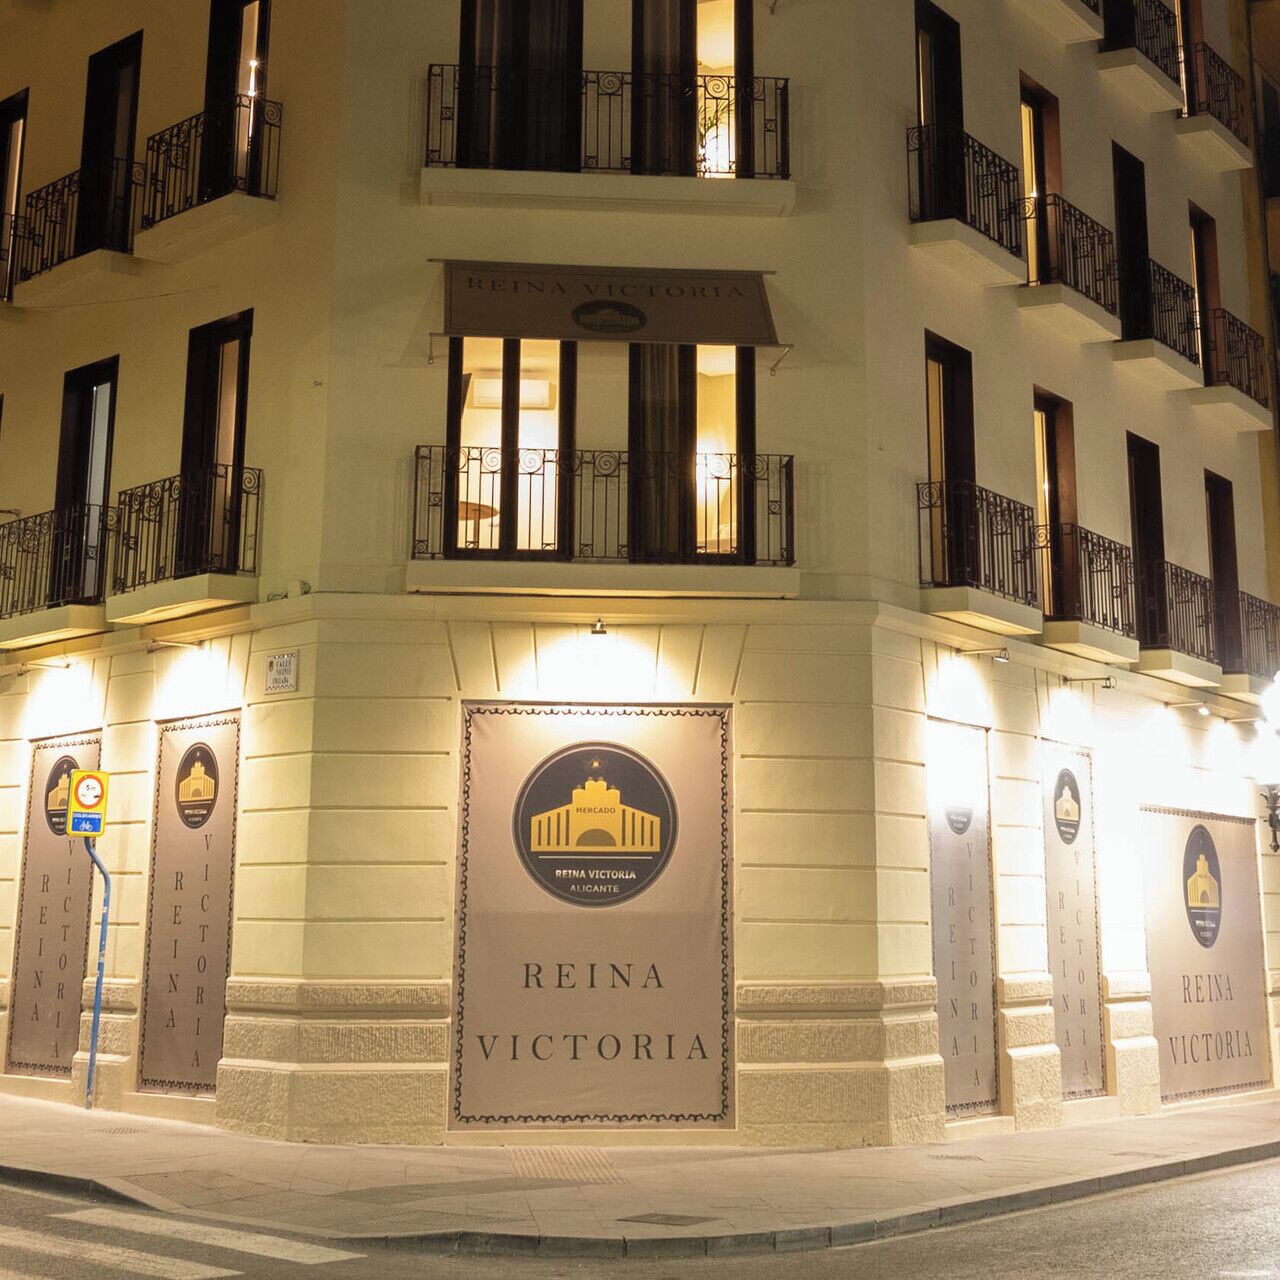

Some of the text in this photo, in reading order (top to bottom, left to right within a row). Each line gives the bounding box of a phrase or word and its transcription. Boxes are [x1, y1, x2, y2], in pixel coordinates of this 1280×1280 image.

[466, 276, 746, 300] REINA VICTORIA
[575, 806, 617, 815] MERCADO
[555, 869, 637, 880] REINA VICTORIA
[569, 884, 620, 894] ALICANTE
[30, 873, 50, 1023] REINA
[50, 838, 77, 1058] VICTORIA
[165, 870, 184, 1029] REINA
[190, 833, 214, 1069] VICTORIA
[522, 962, 666, 989] REINA
[1181, 972, 1234, 1004] REINA
[476, 1033, 709, 1061] VICTORIA
[1168, 1028, 1255, 1065] VICTORIA
